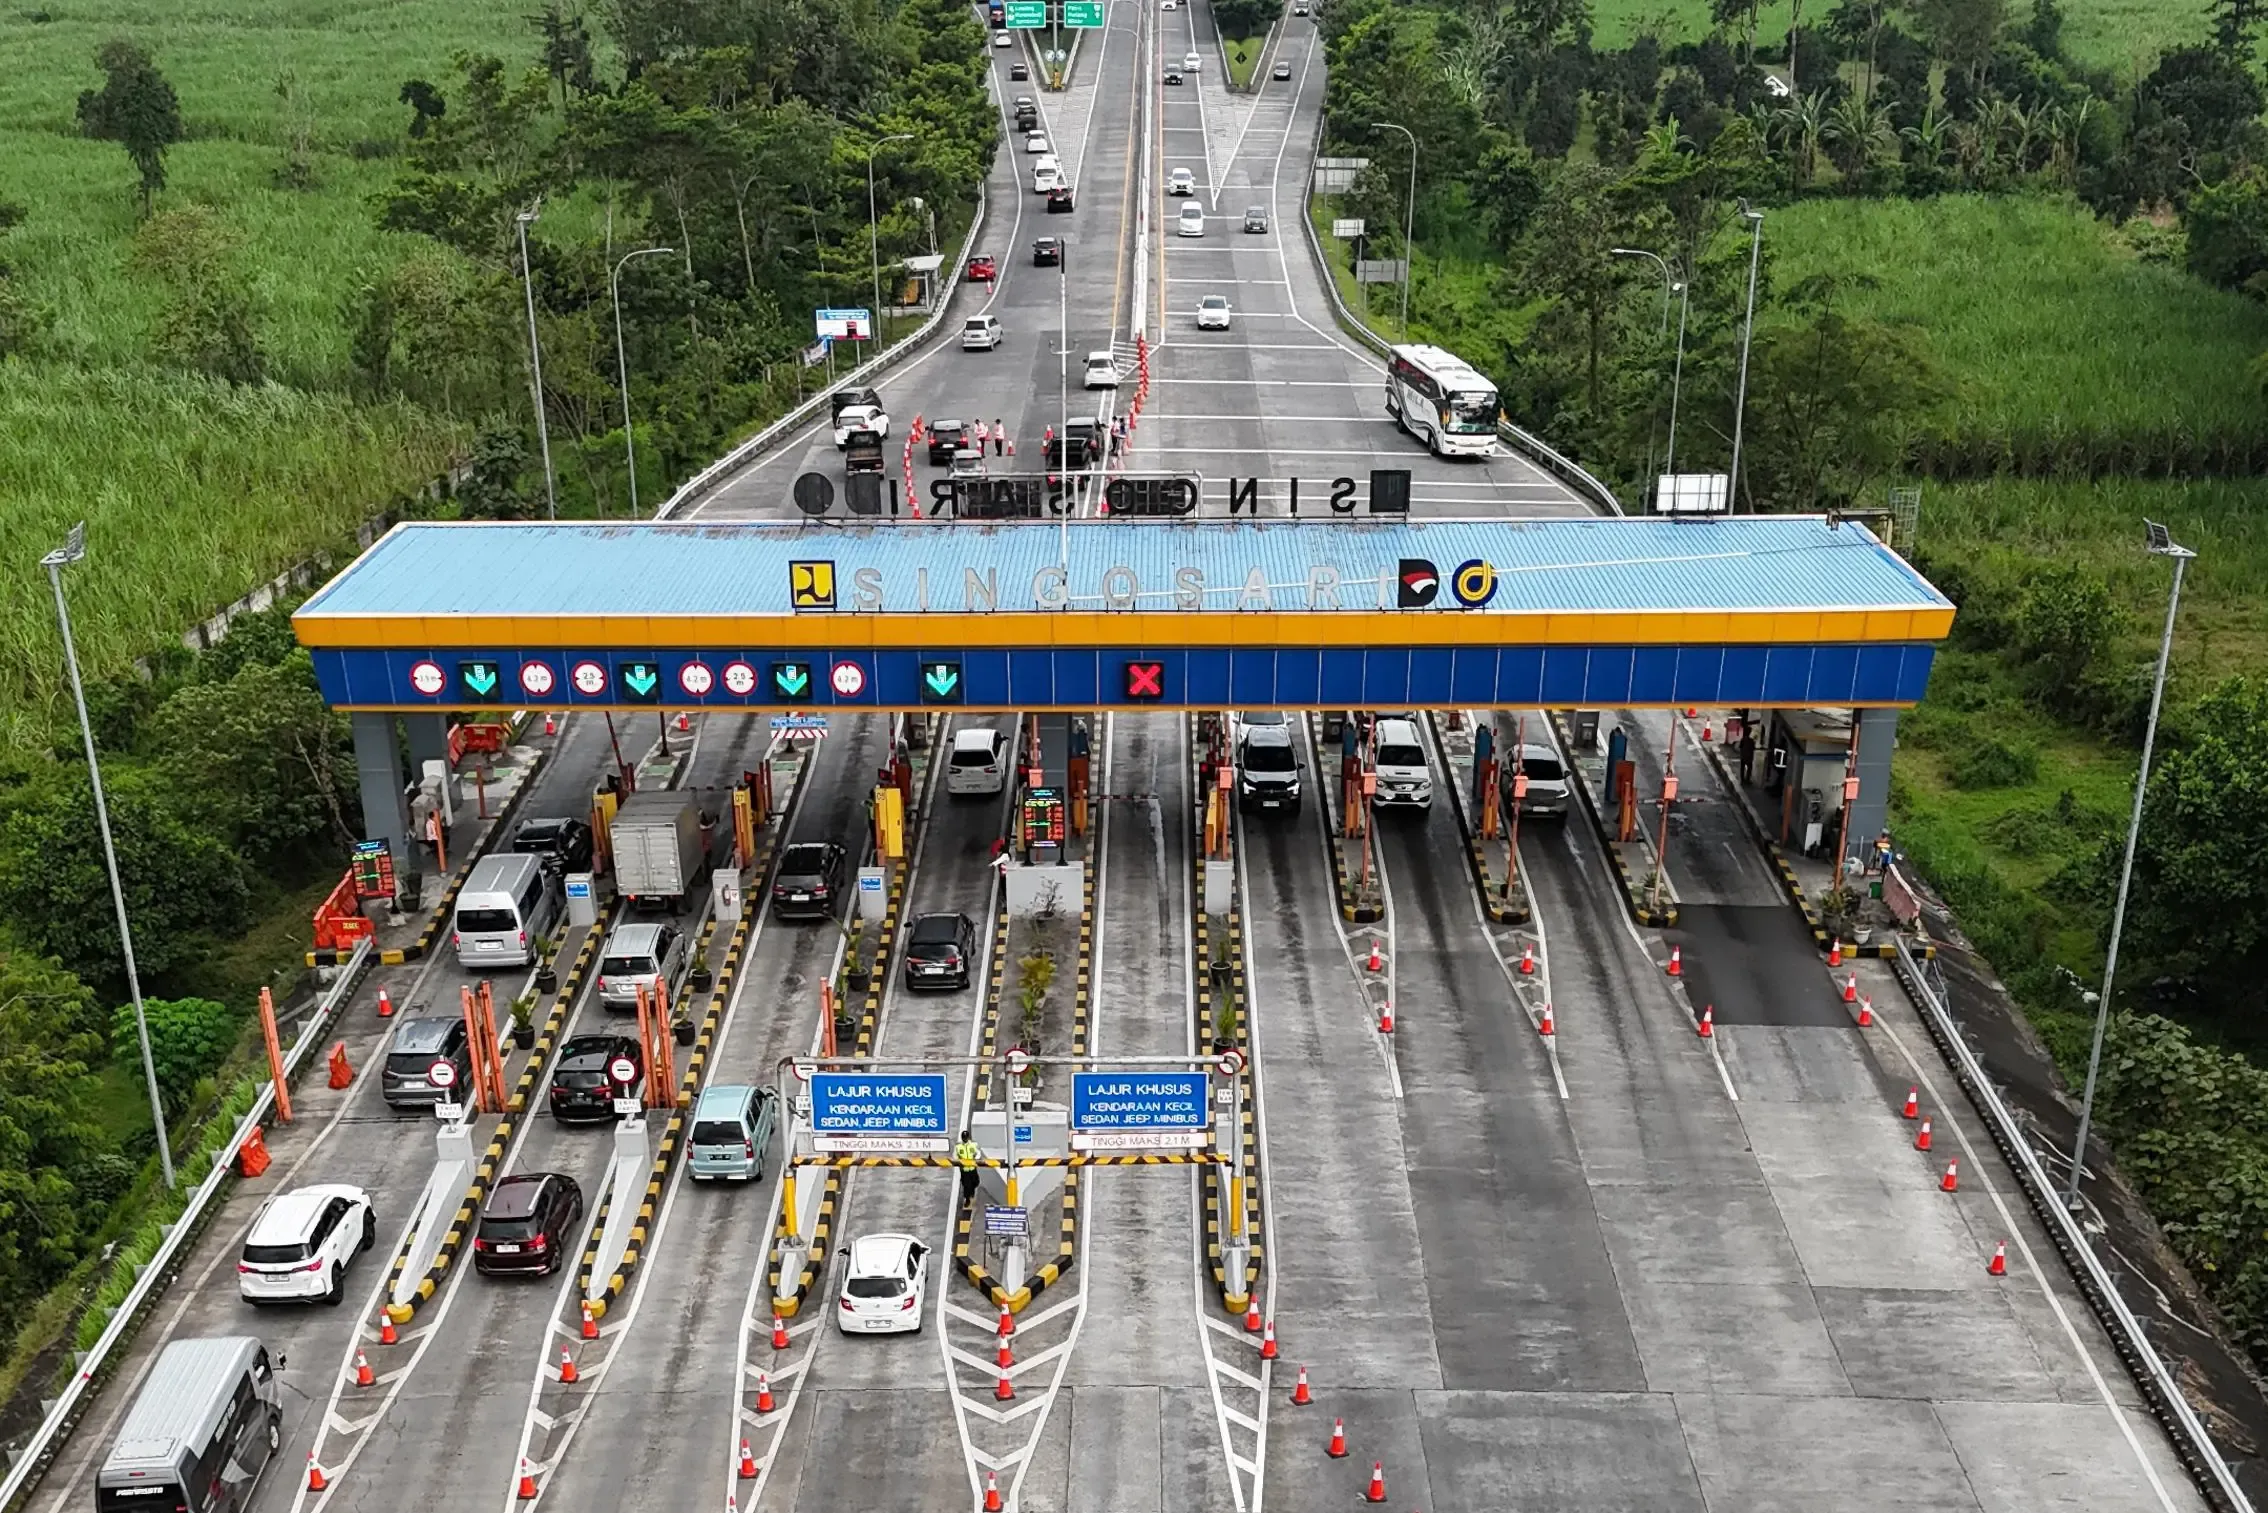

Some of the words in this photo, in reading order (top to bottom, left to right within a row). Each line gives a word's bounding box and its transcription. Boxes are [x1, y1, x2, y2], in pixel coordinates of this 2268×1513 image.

[852, 566, 1389, 609] SINGOSARI
[827, 1086, 872, 1098] LAJUR
[875, 1086, 932, 1098] KHUSUS
[1087, 1084, 1132, 1096] LAJUR
[1135, 1084, 1192, 1096] KHUSUS
[829, 1104, 900, 1115] KENDARAAN
[904, 1104, 936, 1115] KECIL
[1089, 1102, 1160, 1112] KENDARAAN
[1164, 1102, 1196, 1112] KECIL
[893, 1117, 939, 1128] MINIBUS
[1153, 1114, 1199, 1124] MINIBUS
[832, 1140, 868, 1149] TINGGI
[870, 1140, 902, 1149] MAKS
[922, 1140, 931, 1149] M
[1090, 1137, 1127, 1147] TINGGI
[1129, 1136, 1160, 1146] MAKS
[1180, 1136, 1191, 1146] M
